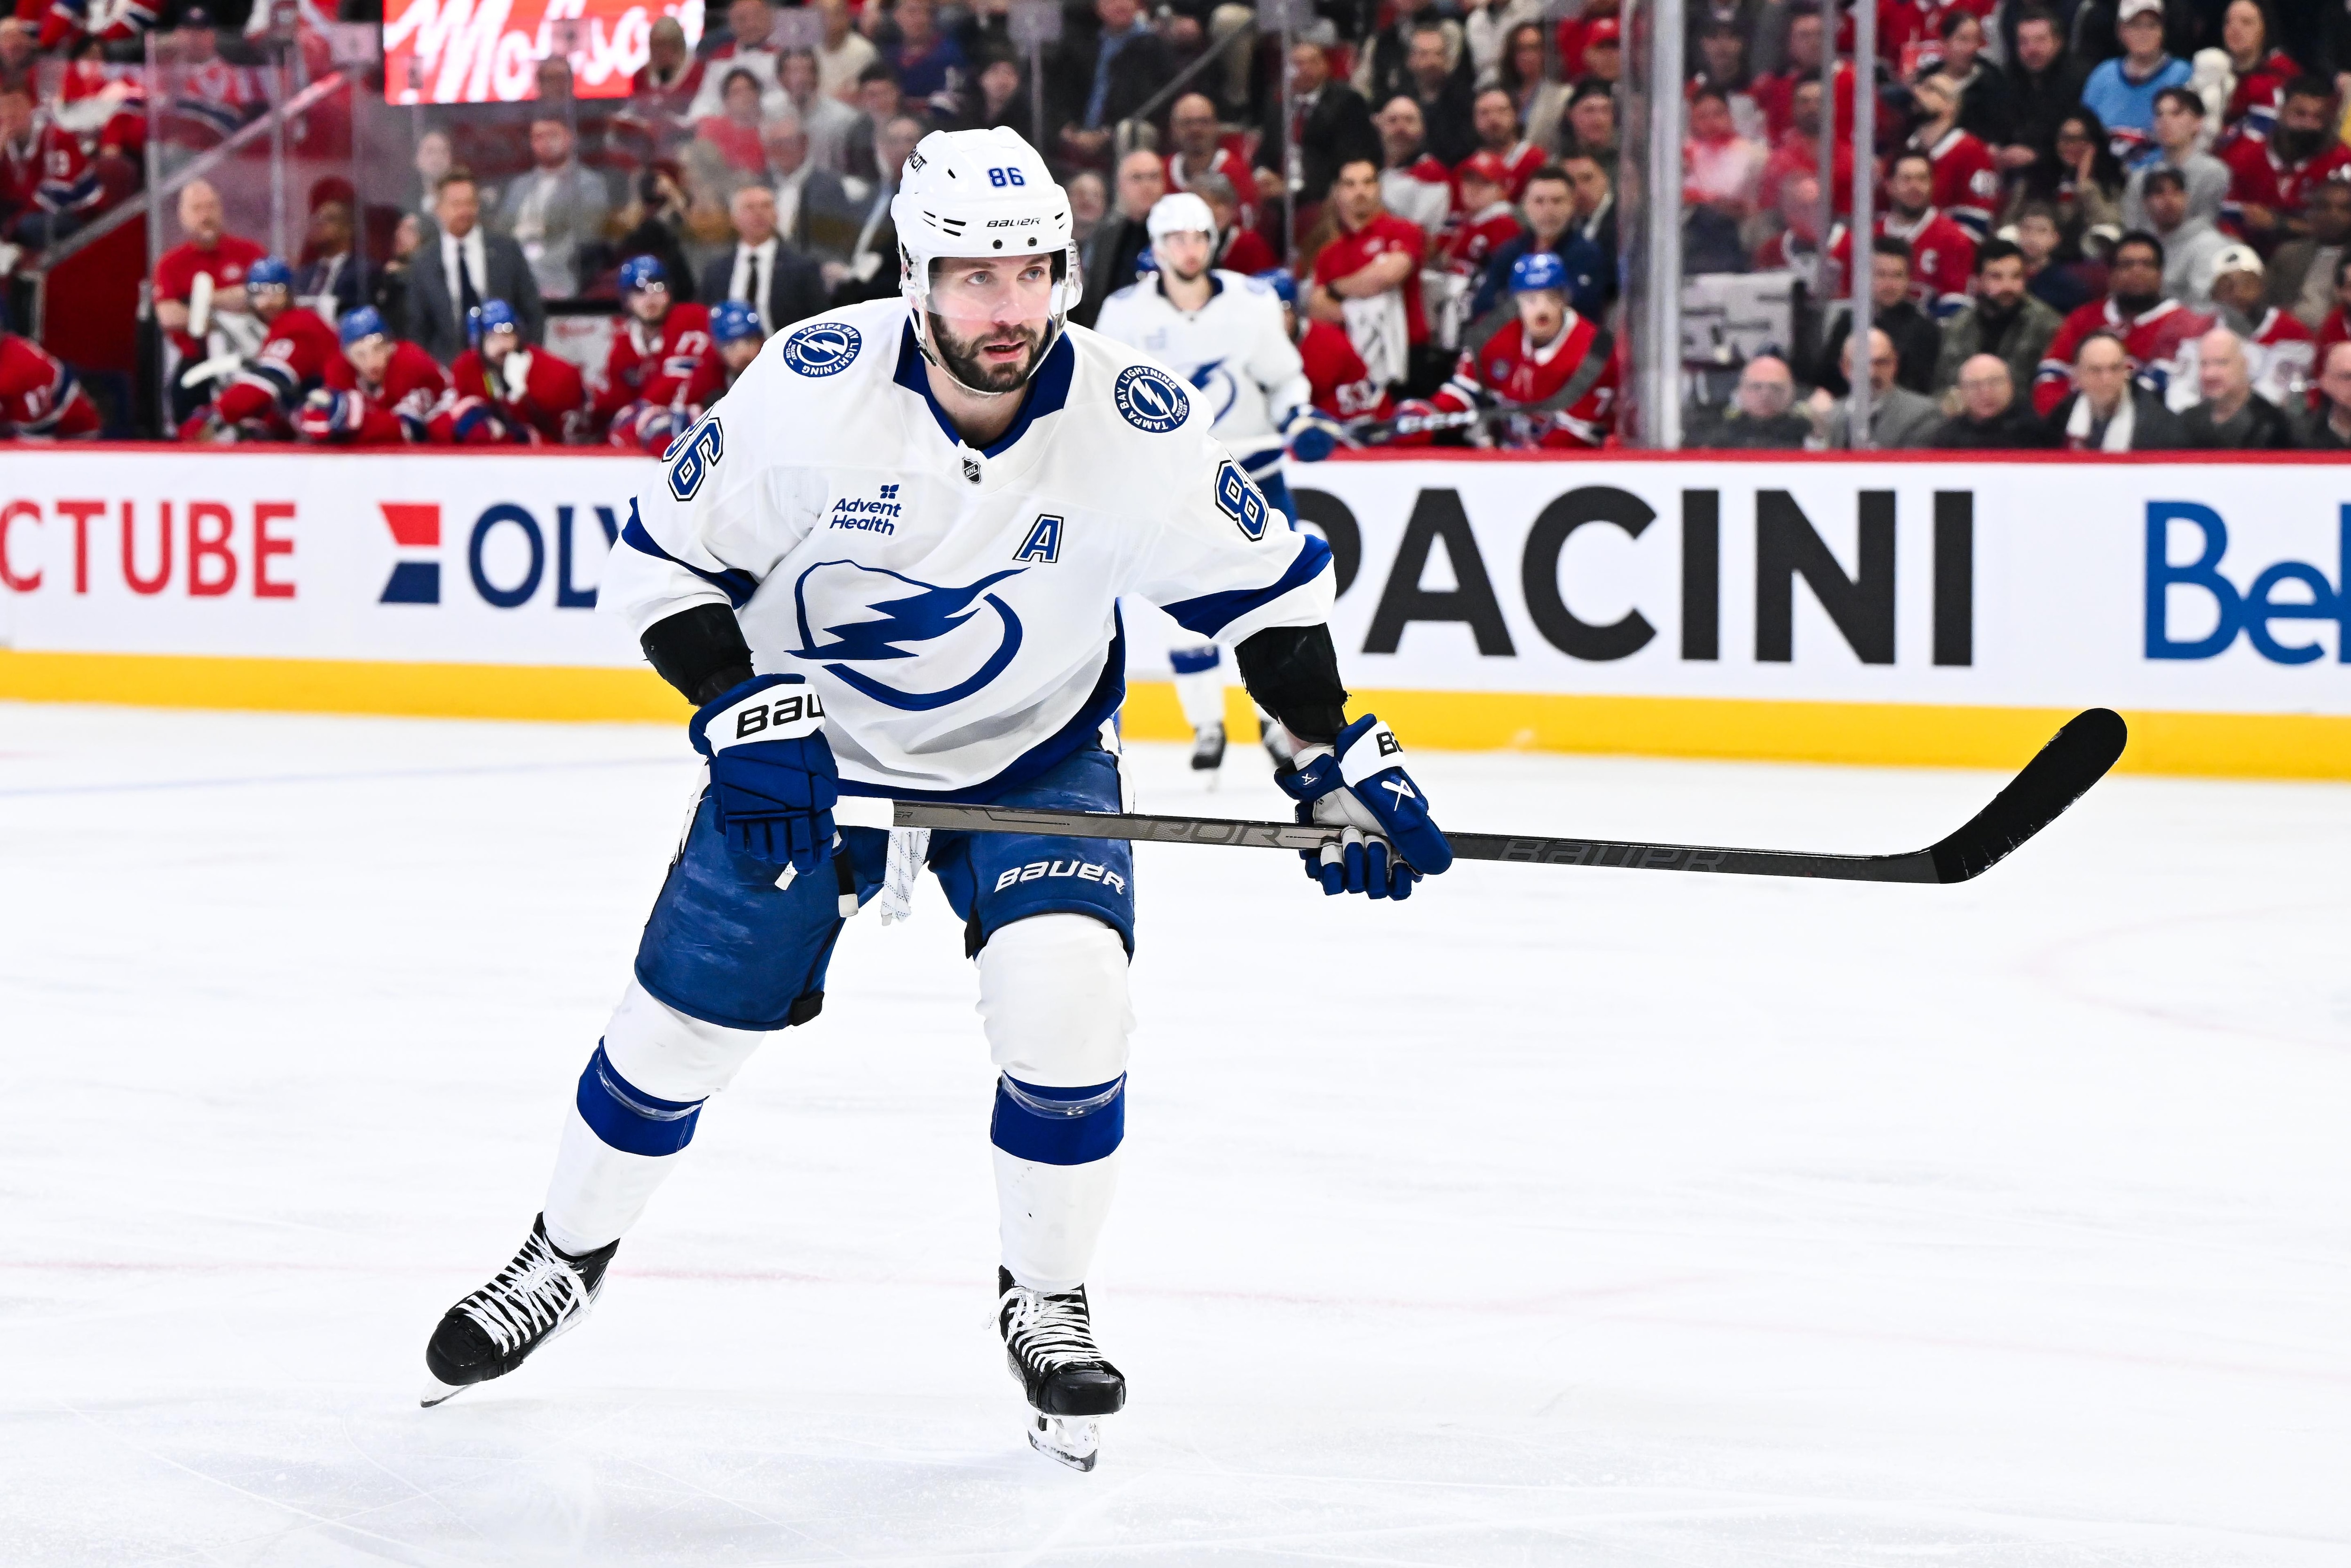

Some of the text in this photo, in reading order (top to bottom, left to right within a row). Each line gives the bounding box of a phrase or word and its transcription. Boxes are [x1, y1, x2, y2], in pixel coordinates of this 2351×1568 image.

[987, 167, 1026, 188] 86
[800, 323, 859, 375] TAMPA BAY LIGHTNING
[1120, 367, 1177, 389] LIGHTNING
[1117, 387, 1129, 410] BAY
[1128, 410, 1169, 430] TAMPA
[965, 465, 978, 476] NHL
[831, 498, 902, 518] Advent
[1215, 459, 1269, 542] 8
[829, 514, 895, 536] Health
[0, 498, 297, 599] CTUBE
[1012, 513, 1065, 564] A
